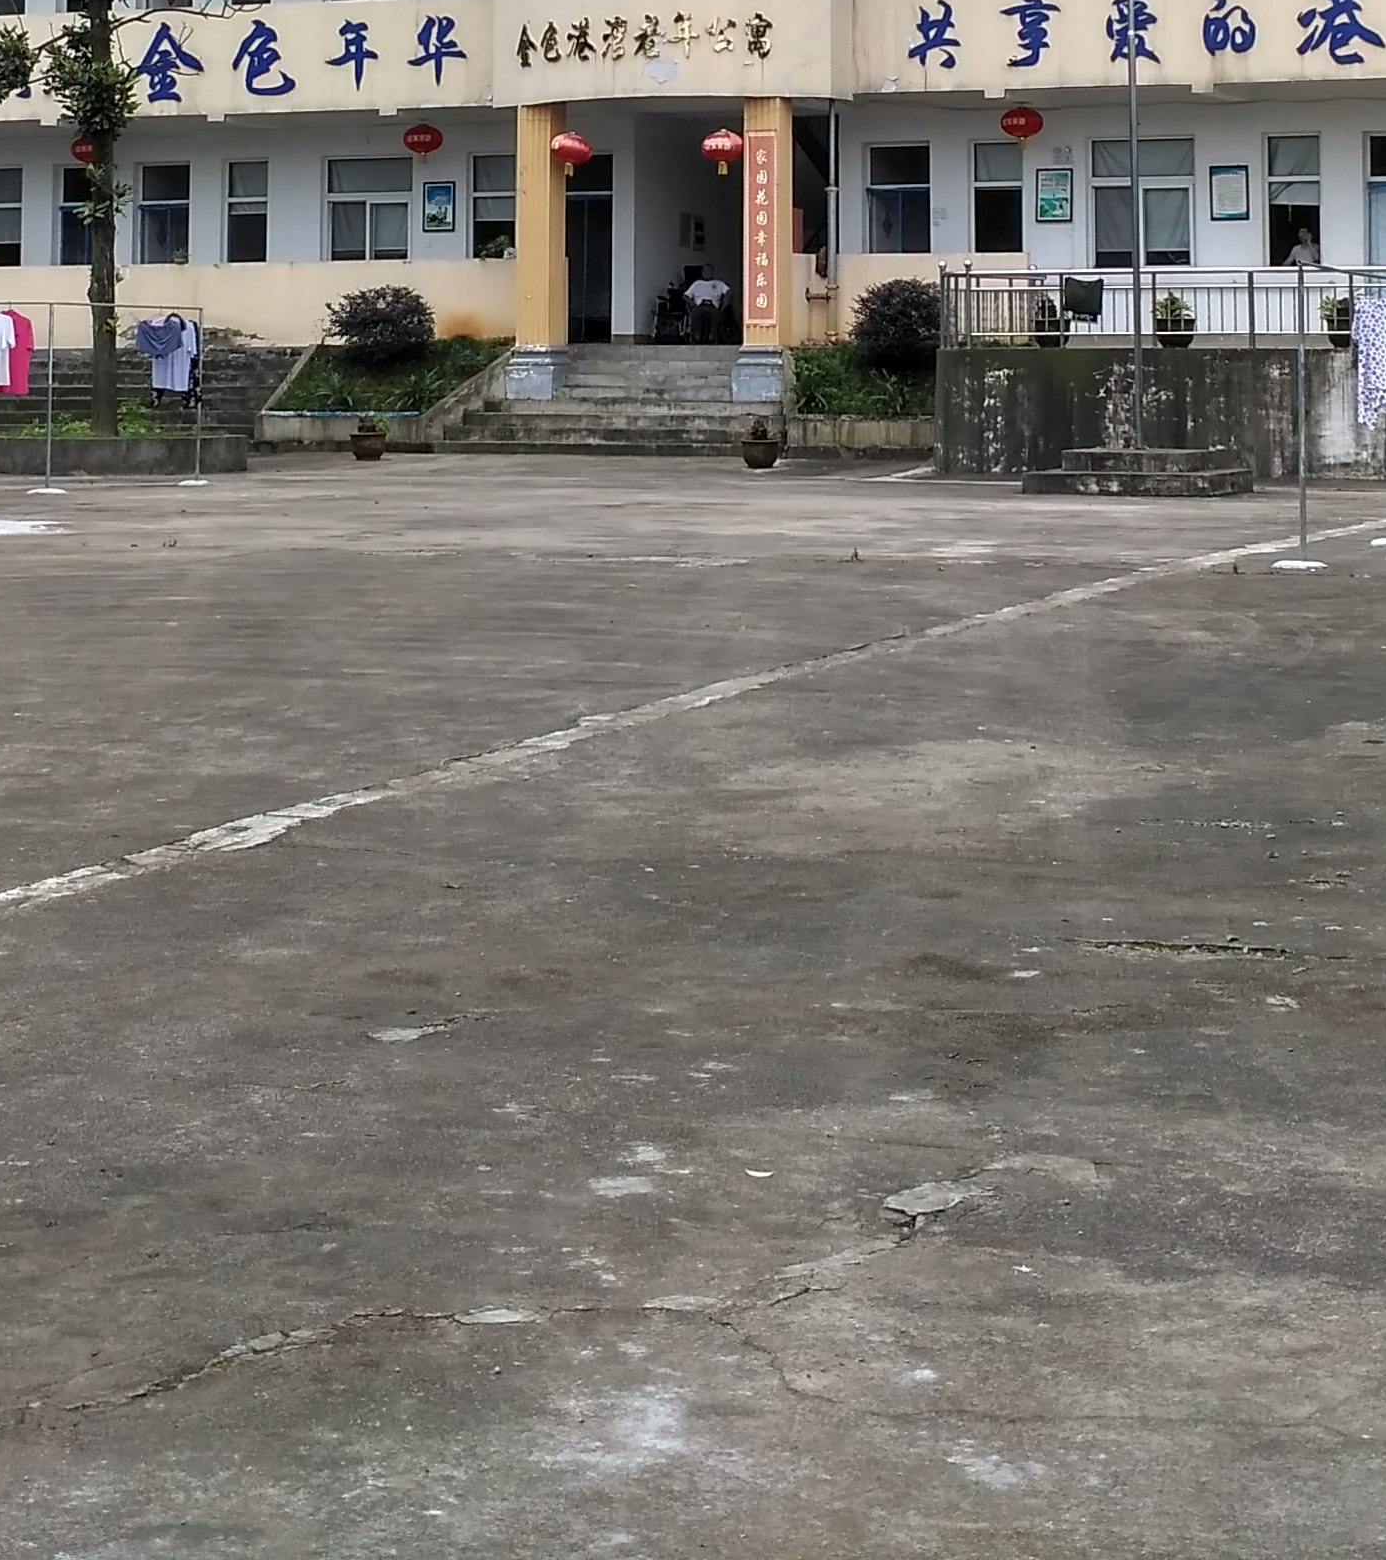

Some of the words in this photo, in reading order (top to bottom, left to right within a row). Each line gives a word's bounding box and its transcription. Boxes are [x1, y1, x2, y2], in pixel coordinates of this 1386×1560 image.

[135, 14, 467, 103] 金色年华
[516, 11, 773, 68] 金色港湾老年公寓
[754, 149, 769, 309] 家园花园幸福乐园
